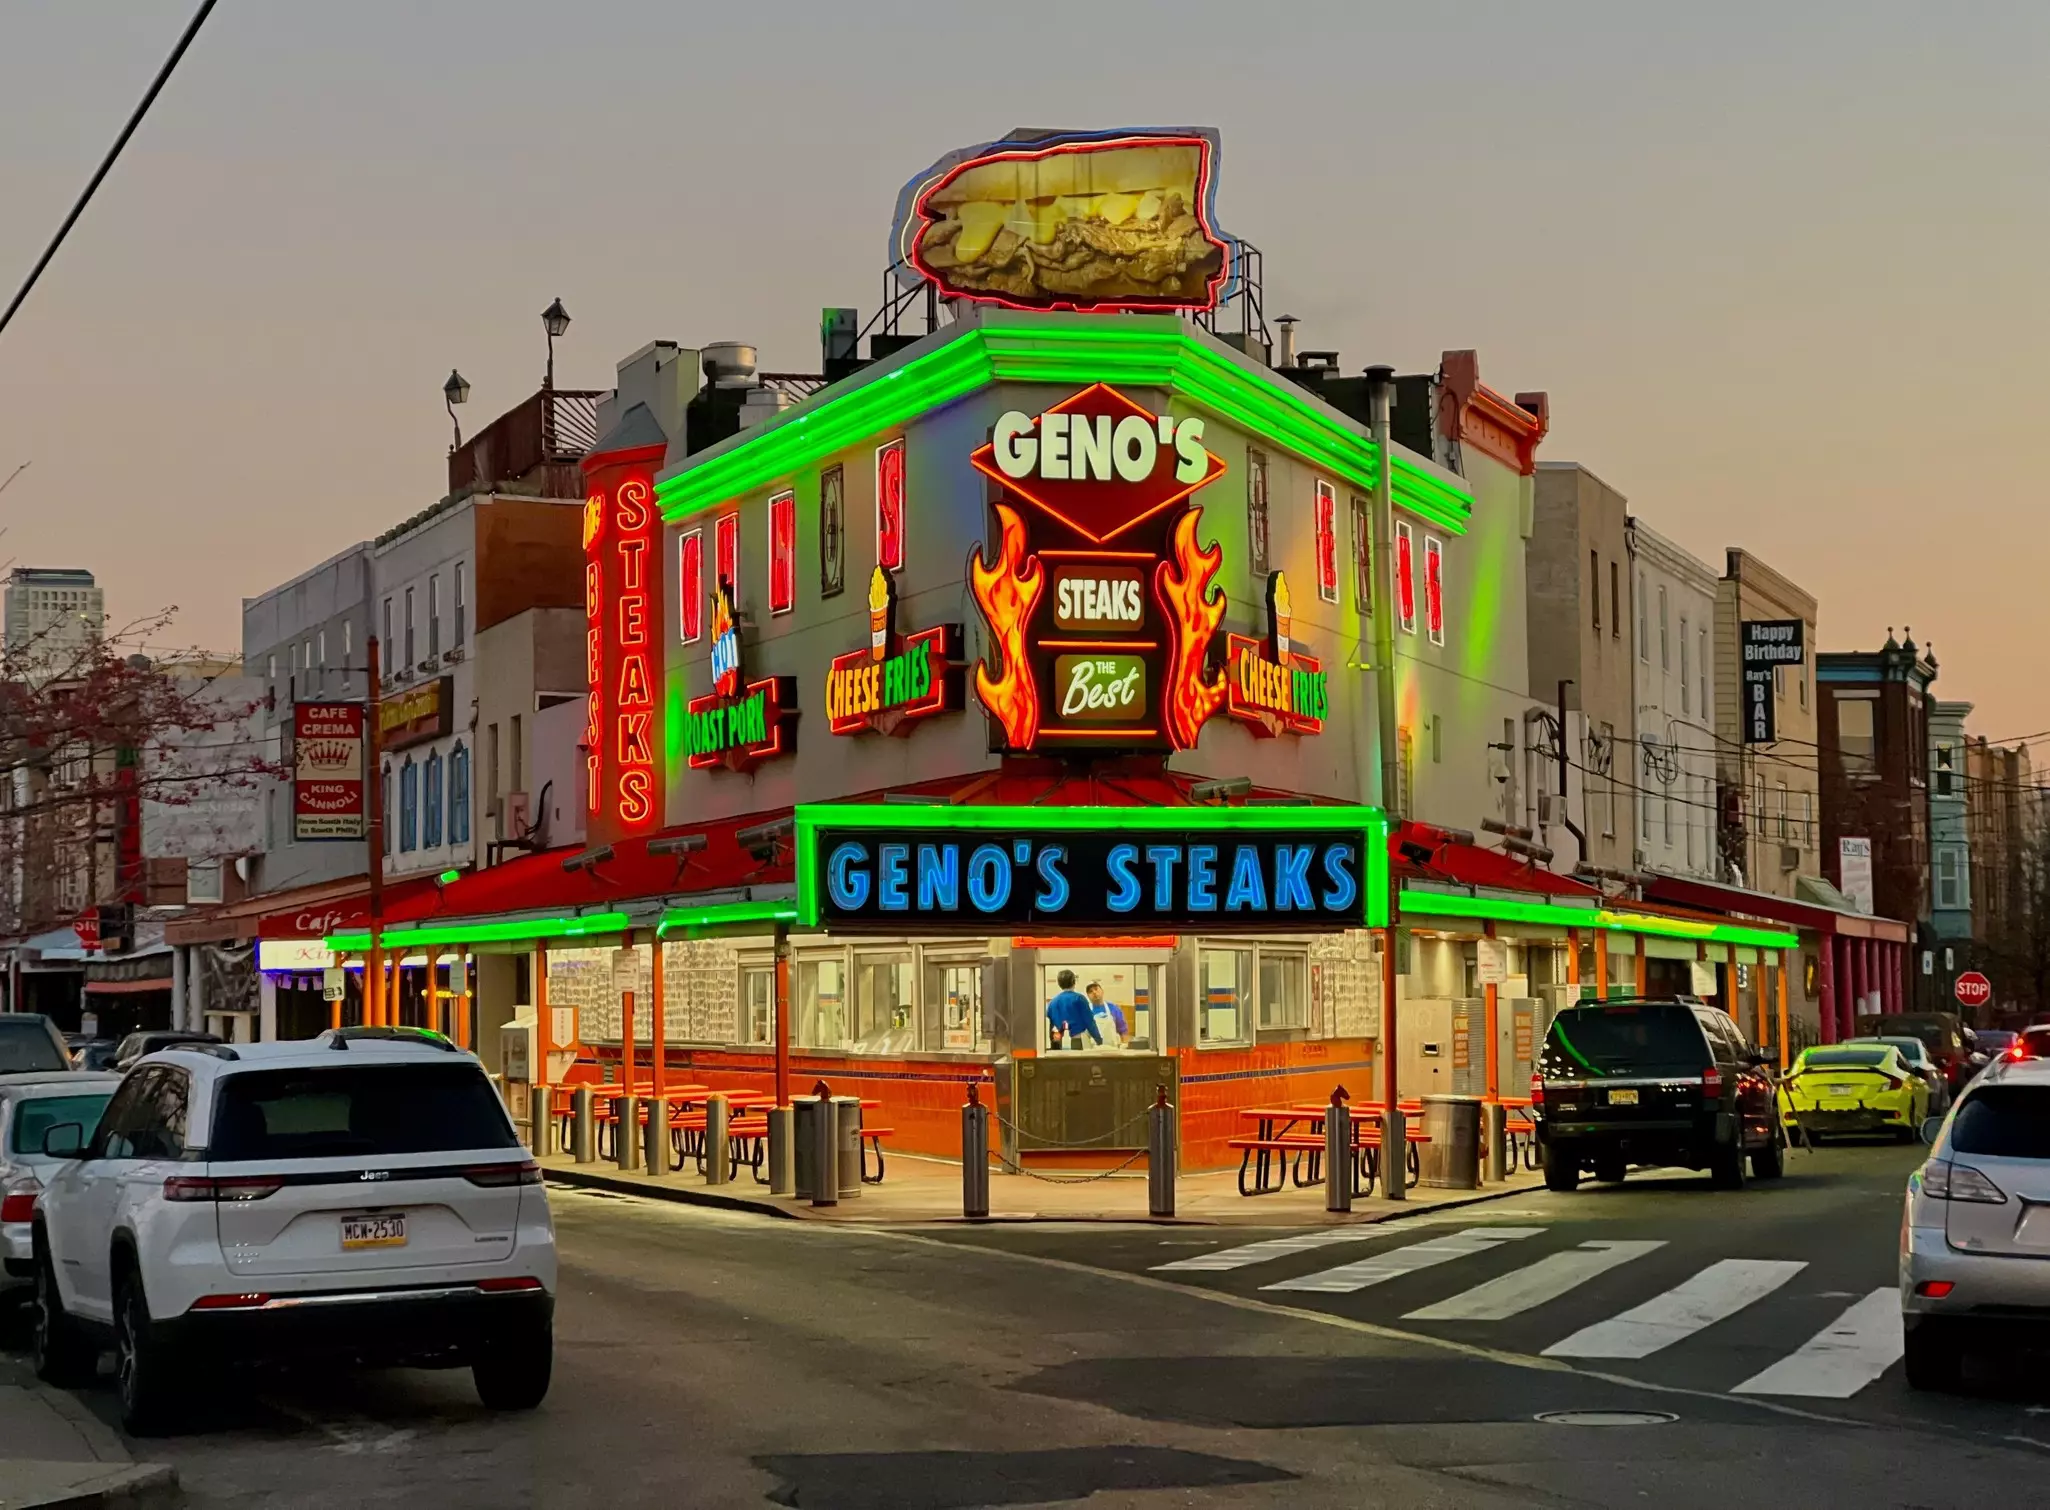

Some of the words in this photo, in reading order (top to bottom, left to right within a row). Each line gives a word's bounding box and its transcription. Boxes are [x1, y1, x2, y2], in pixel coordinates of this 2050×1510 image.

[993, 410, 1209, 484] GENO'S
[1057, 579, 1142, 621] STEAKS
[1751, 624, 1794, 642] Happy
[617, 481, 654, 823] STEAKS
[711, 627, 738, 685] HOT
[1745, 643, 1802, 661] Birthday
[1096, 660, 1116, 675] THE
[1746, 670, 1772, 682] Ray's
[585, 563, 604, 812] BEST
[825, 664, 881, 721] CHEESE
[884, 639, 931, 708] FRIES
[1062, 660, 1140, 717] Best
[1240, 647, 1289, 712] CHEESE
[1291, 669, 1329, 721] FRIES
[308, 707, 349, 719] CAFE
[1753, 684, 1766, 739] BAR
[302, 723, 355, 735] CREMA
[683, 708, 725, 757] ROAST
[728, 689, 766, 747] PORK
[299, 790, 358, 810] CANNOLI
[311, 784, 345, 794] KING
[343, 818, 361, 826] Italy
[1842, 839, 1870, 857] Ray's
[827, 839, 1070, 912] GENO'S
[1106, 843, 1357, 913] STEAKS
[296, 911, 343, 936] Café
[1957, 981, 1989, 996] STOP
[360, 1170, 389, 1181] Jeep
